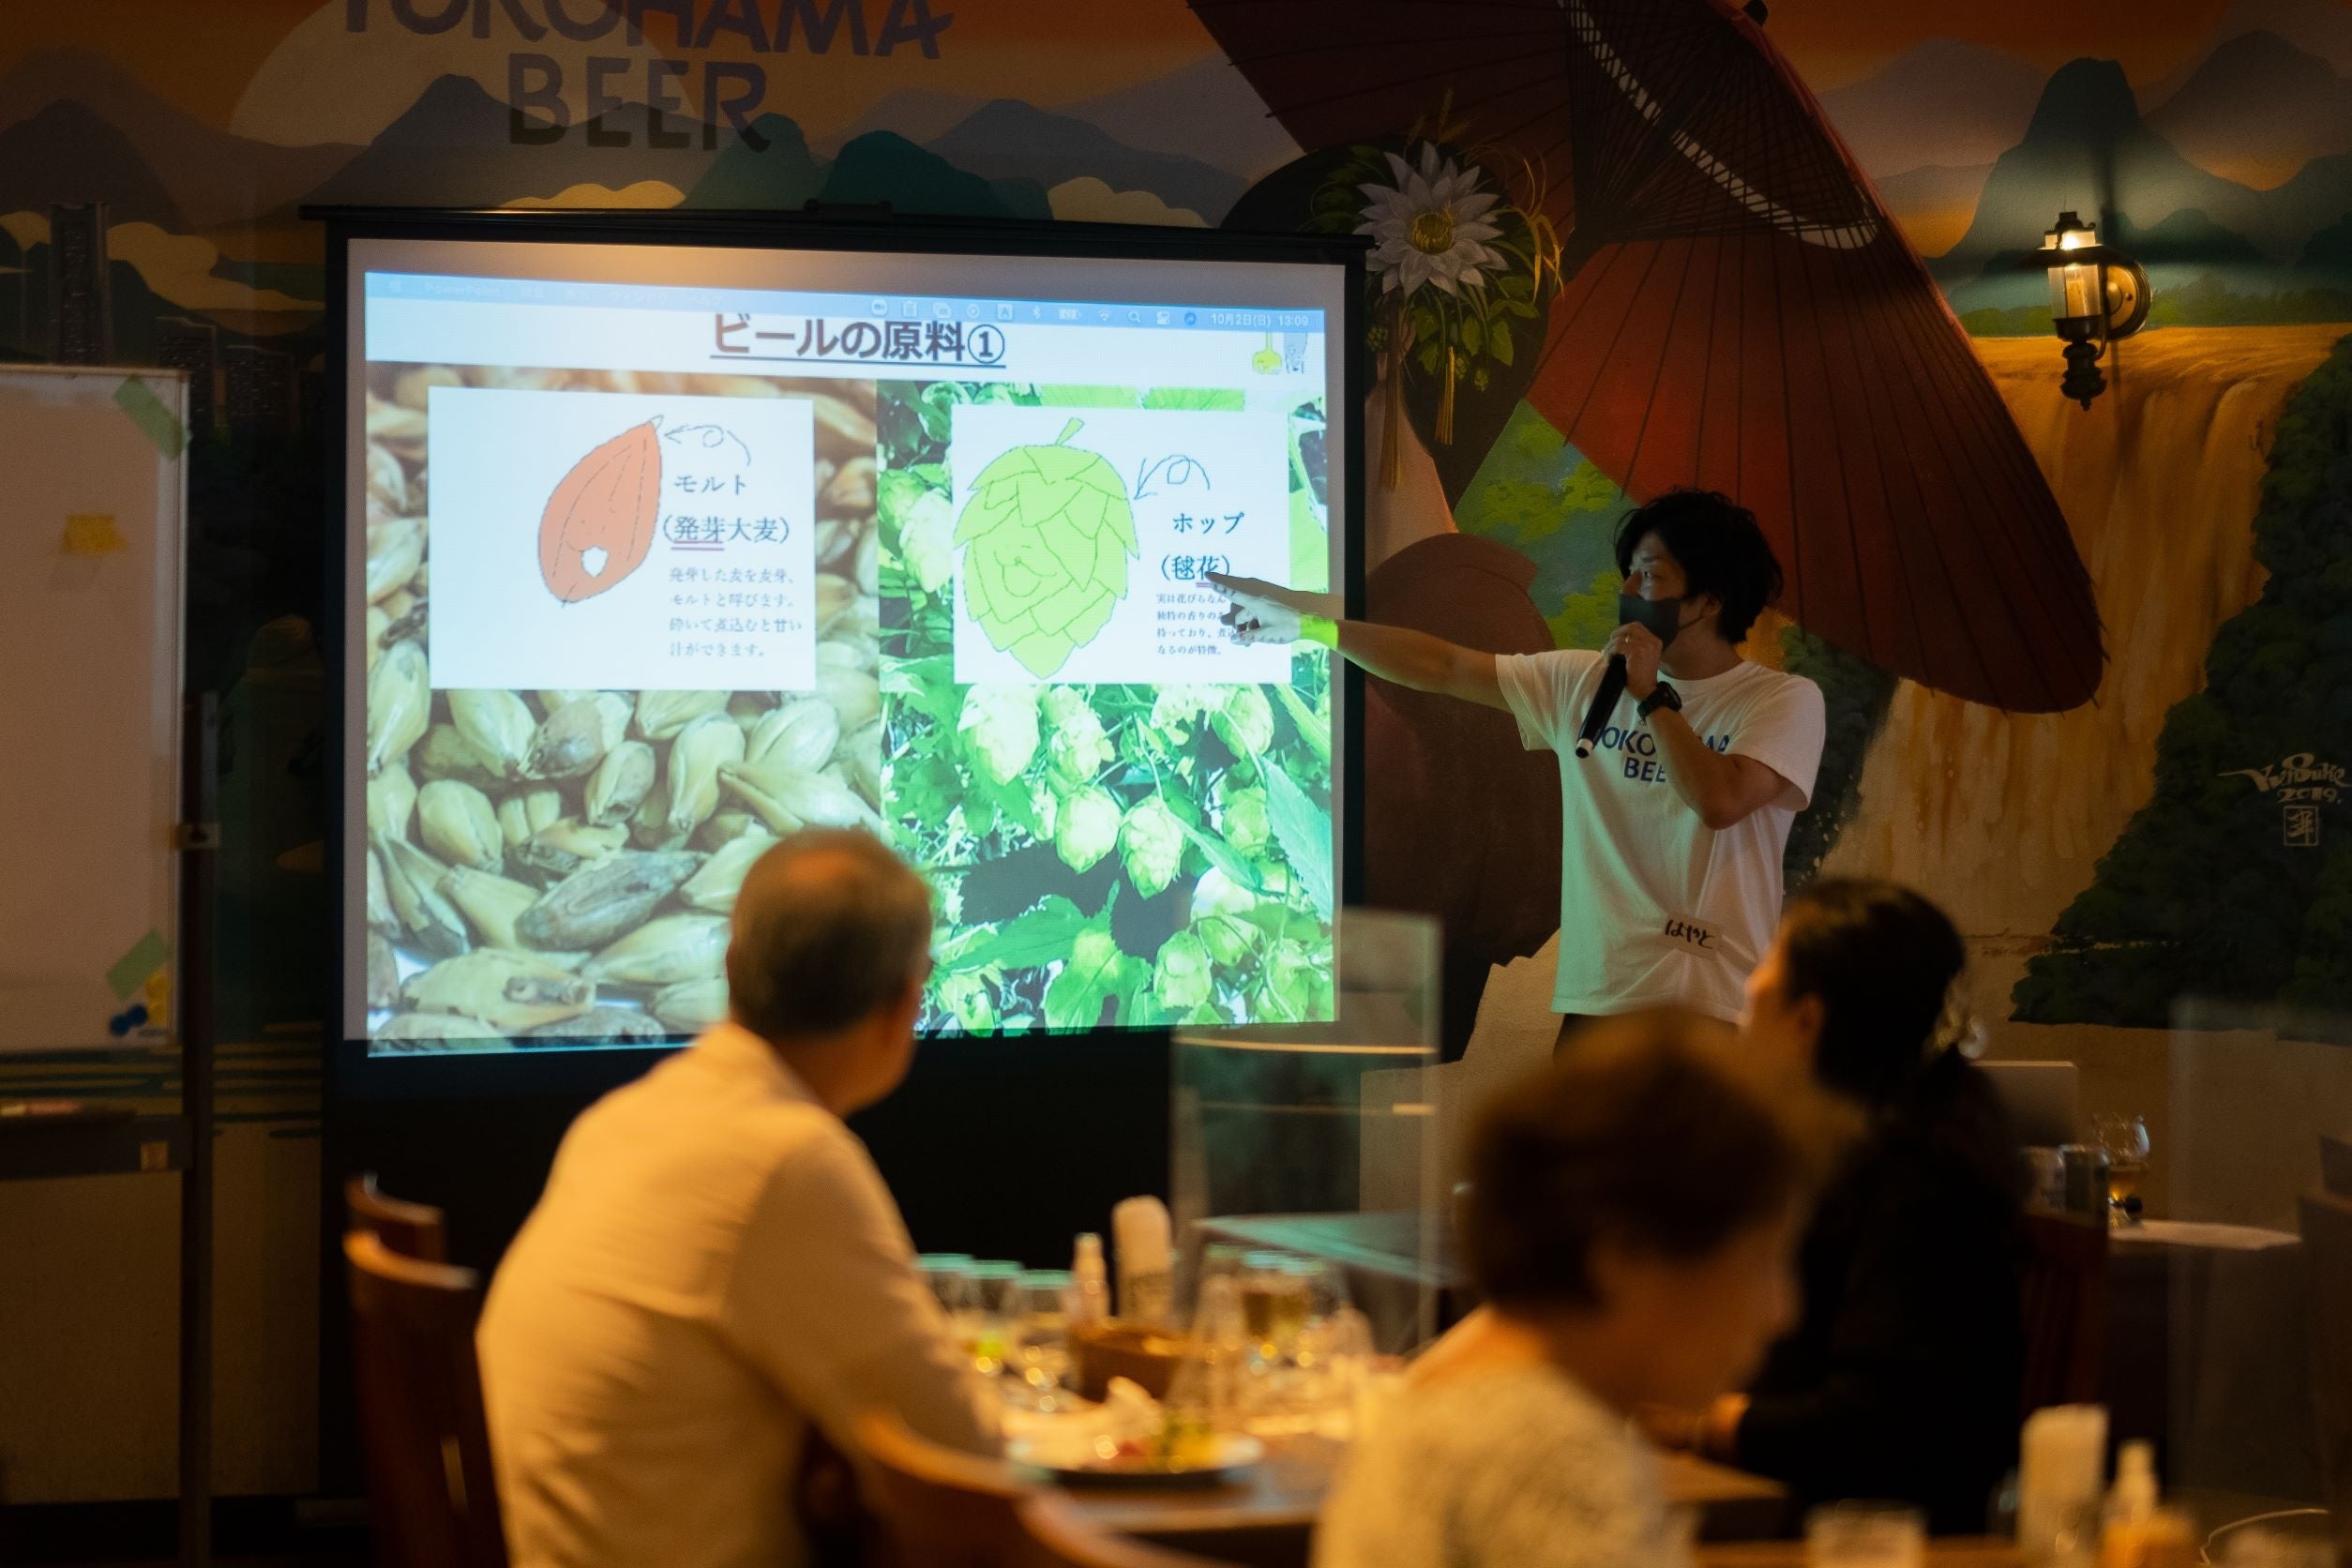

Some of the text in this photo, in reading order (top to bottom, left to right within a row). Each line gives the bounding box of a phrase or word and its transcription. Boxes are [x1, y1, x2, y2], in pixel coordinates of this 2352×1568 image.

[507, 52, 772, 153] BEER
[715, 312, 1005, 364] ビールの原料①
[673, 474, 746, 495] モルト
[663, 515, 790, 544] (発芽大麦)
[1172, 512, 1245, 535] ホップ
[1623, 756, 1666, 783] BEE
[1665, 919, 1715, 950] はやと
